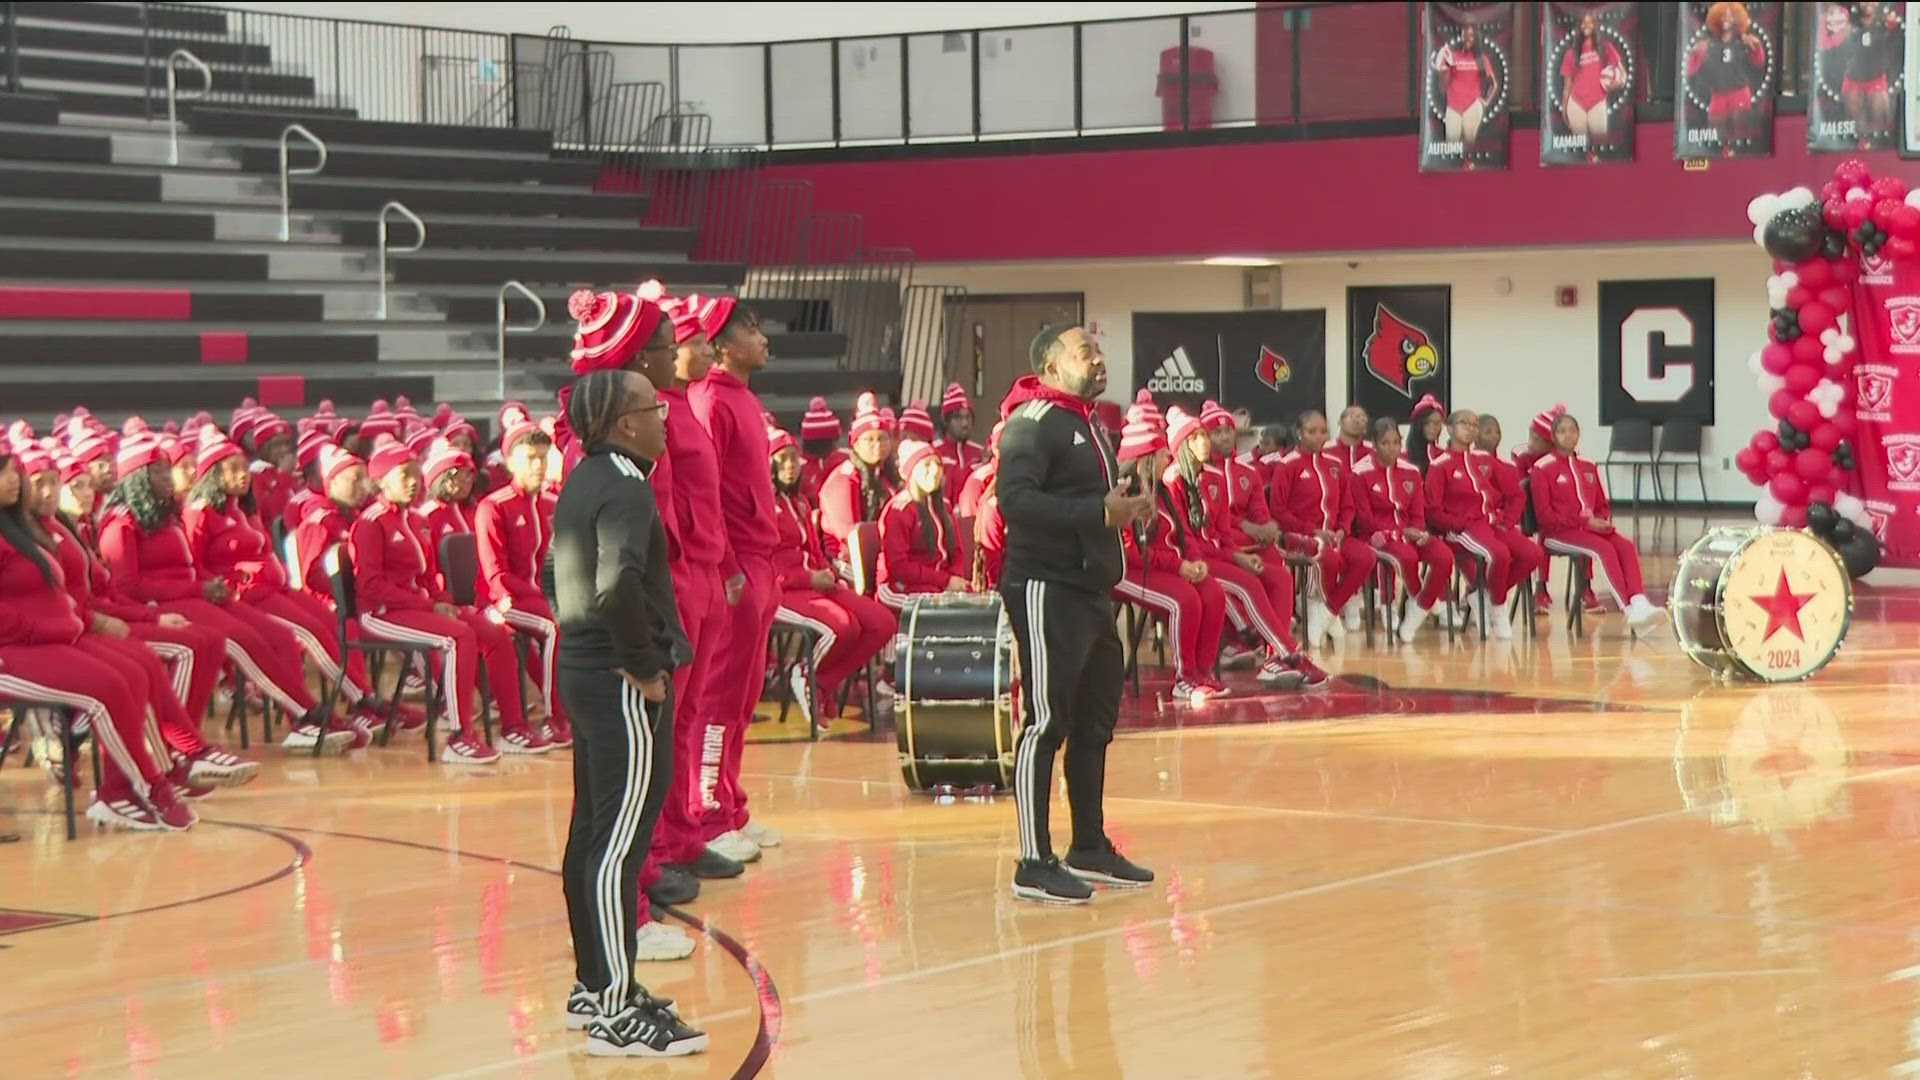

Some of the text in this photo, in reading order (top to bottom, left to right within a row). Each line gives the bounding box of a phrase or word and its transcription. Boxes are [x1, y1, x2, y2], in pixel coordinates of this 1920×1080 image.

[1722, 47, 1732, 63] 3
[1688, 127, 1719, 144] OLIVIA
[1819, 120, 1857, 138] KALESE
[1427, 141, 1464, 156] AUTUMN
[1552, 133, 1587, 150] KAMARI
[1620, 305, 1694, 402] C
[1147, 375, 1205, 393] adidas
[1766, 648, 1801, 670] 2024
[701, 724, 727, 764] DRUM
